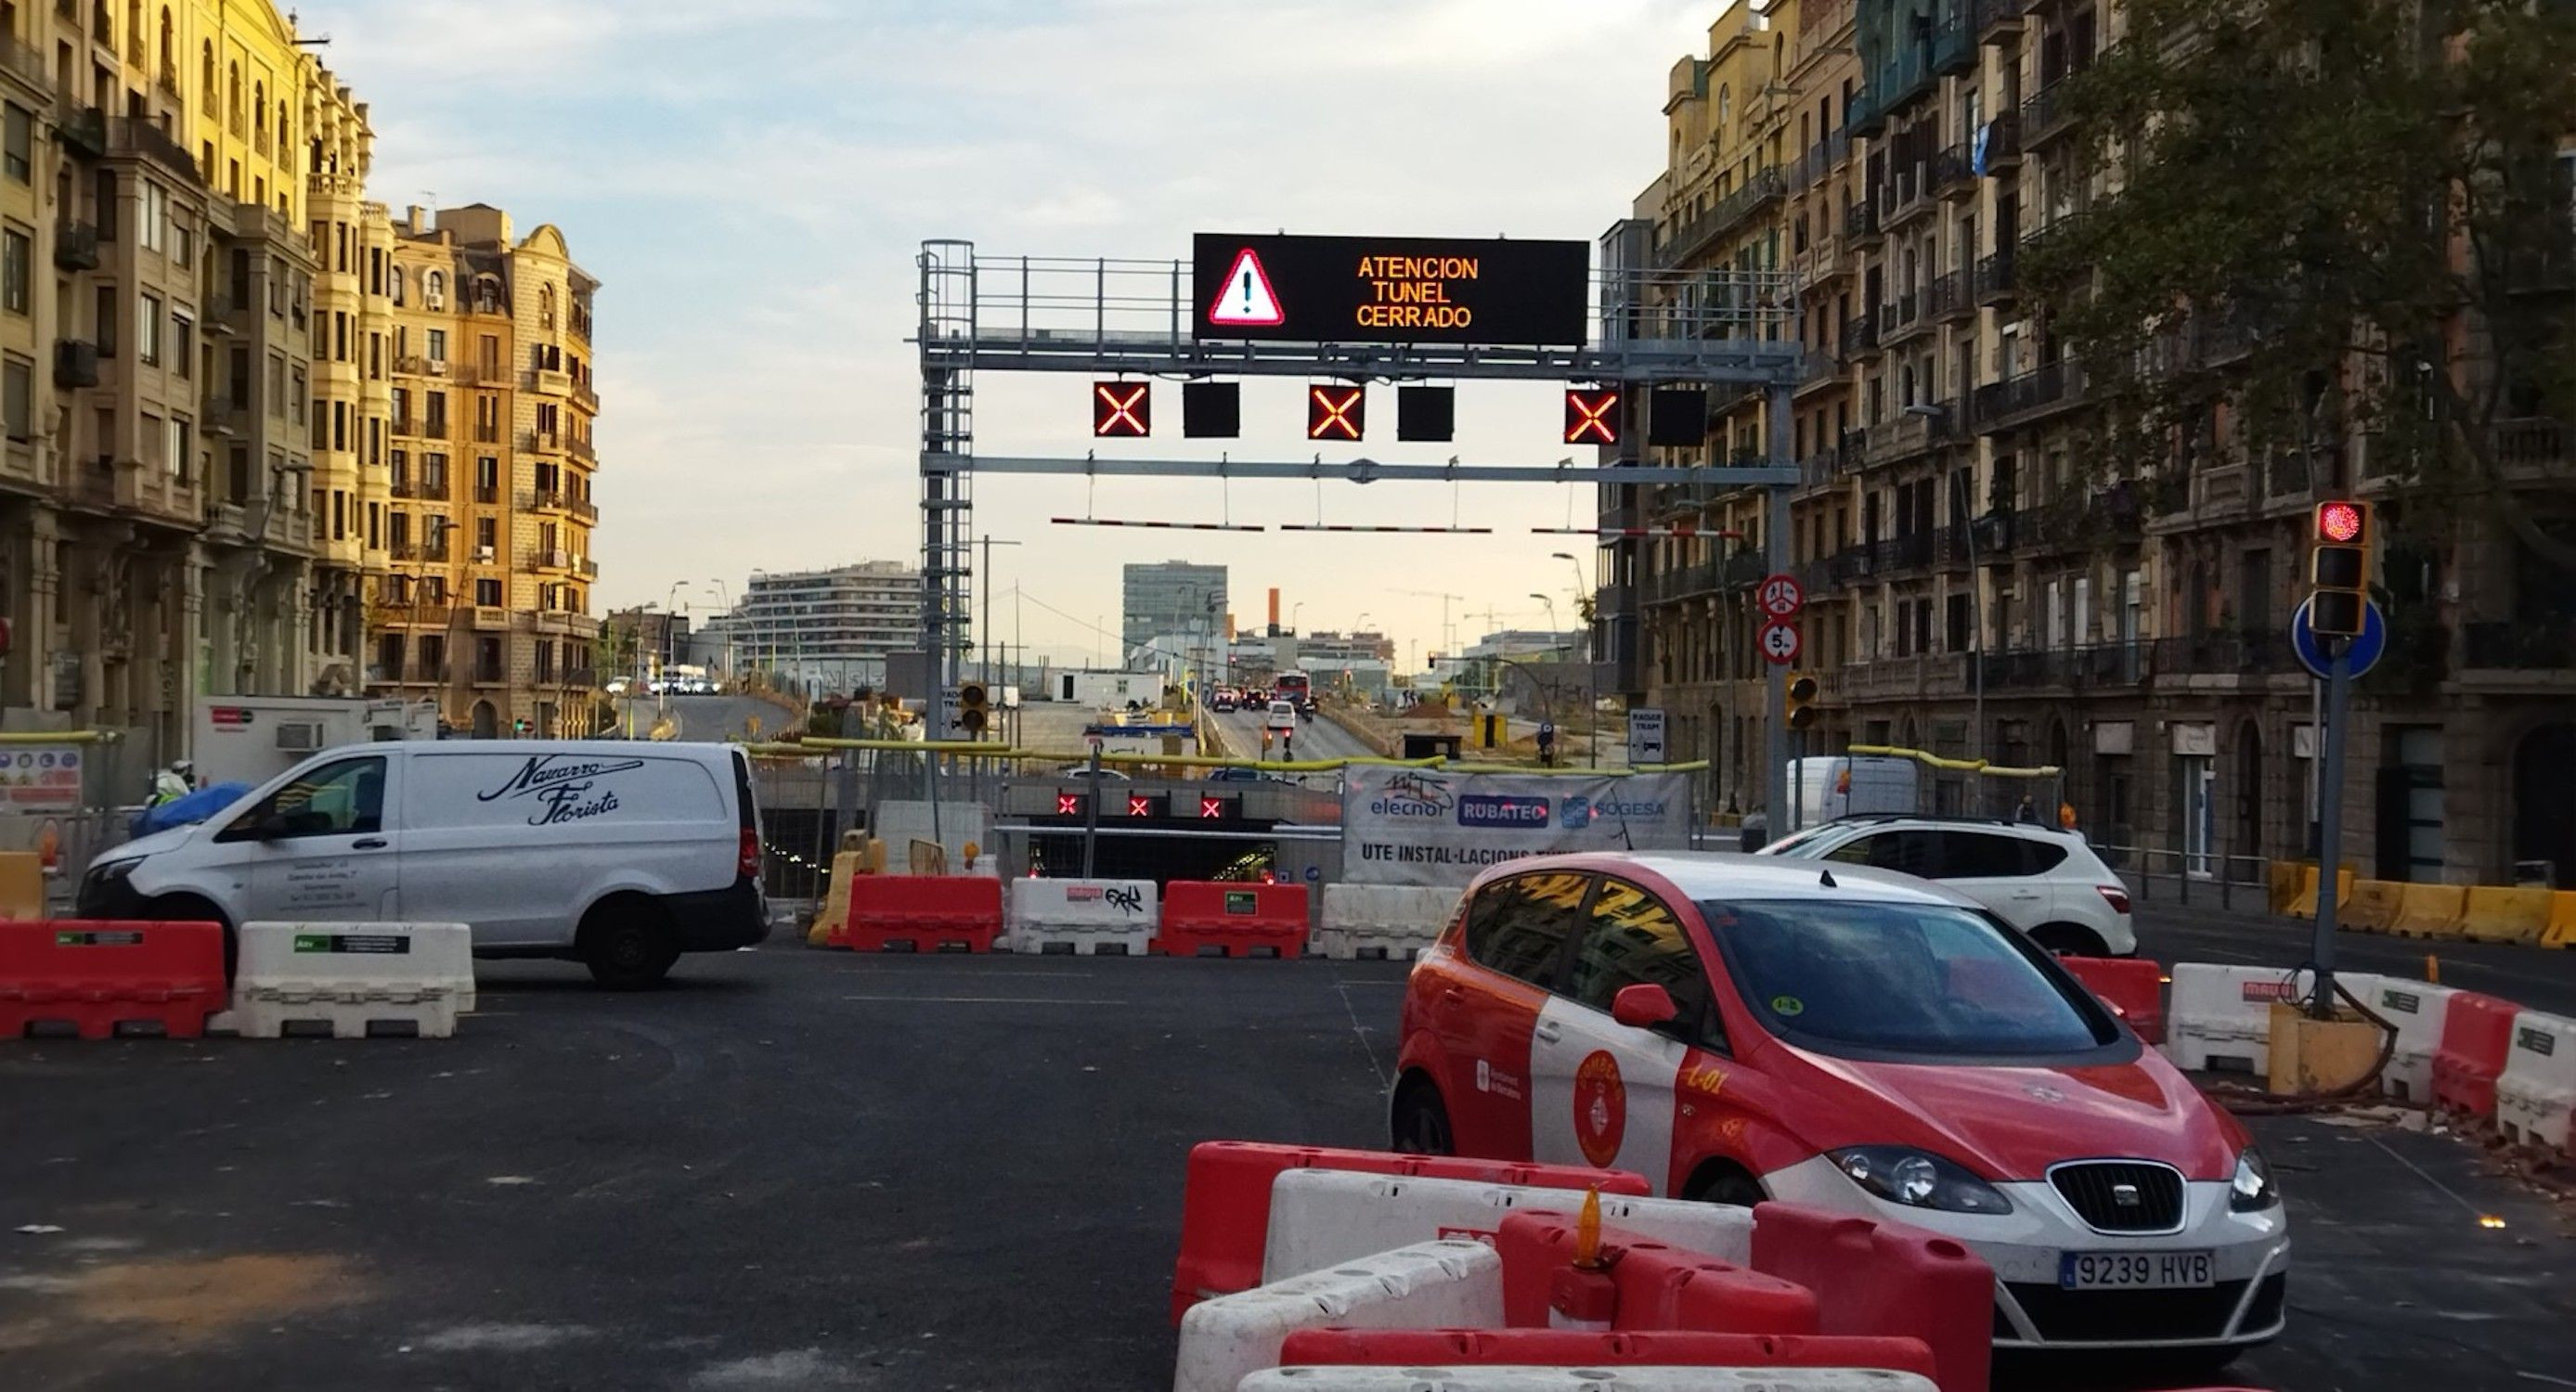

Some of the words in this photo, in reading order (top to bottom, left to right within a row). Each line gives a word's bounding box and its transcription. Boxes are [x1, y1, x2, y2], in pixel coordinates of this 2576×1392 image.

[1358, 256, 1479, 278] ATENCION
[1372, 281, 1451, 303] TUNEL
[1356, 305, 1471, 328] CERRADO
[1772, 634, 1782, 648] 5
[527, 781, 619, 826] Florista
[1371, 799, 1443, 817] elecnor
[1464, 803, 1547, 820] RUBATEC
[1596, 802, 1665, 816] SOGESA
[1362, 844, 1393, 861] UTE
[2080, 1256, 2150, 1284] 9239
[2161, 1256, 2208, 1284] HVB
